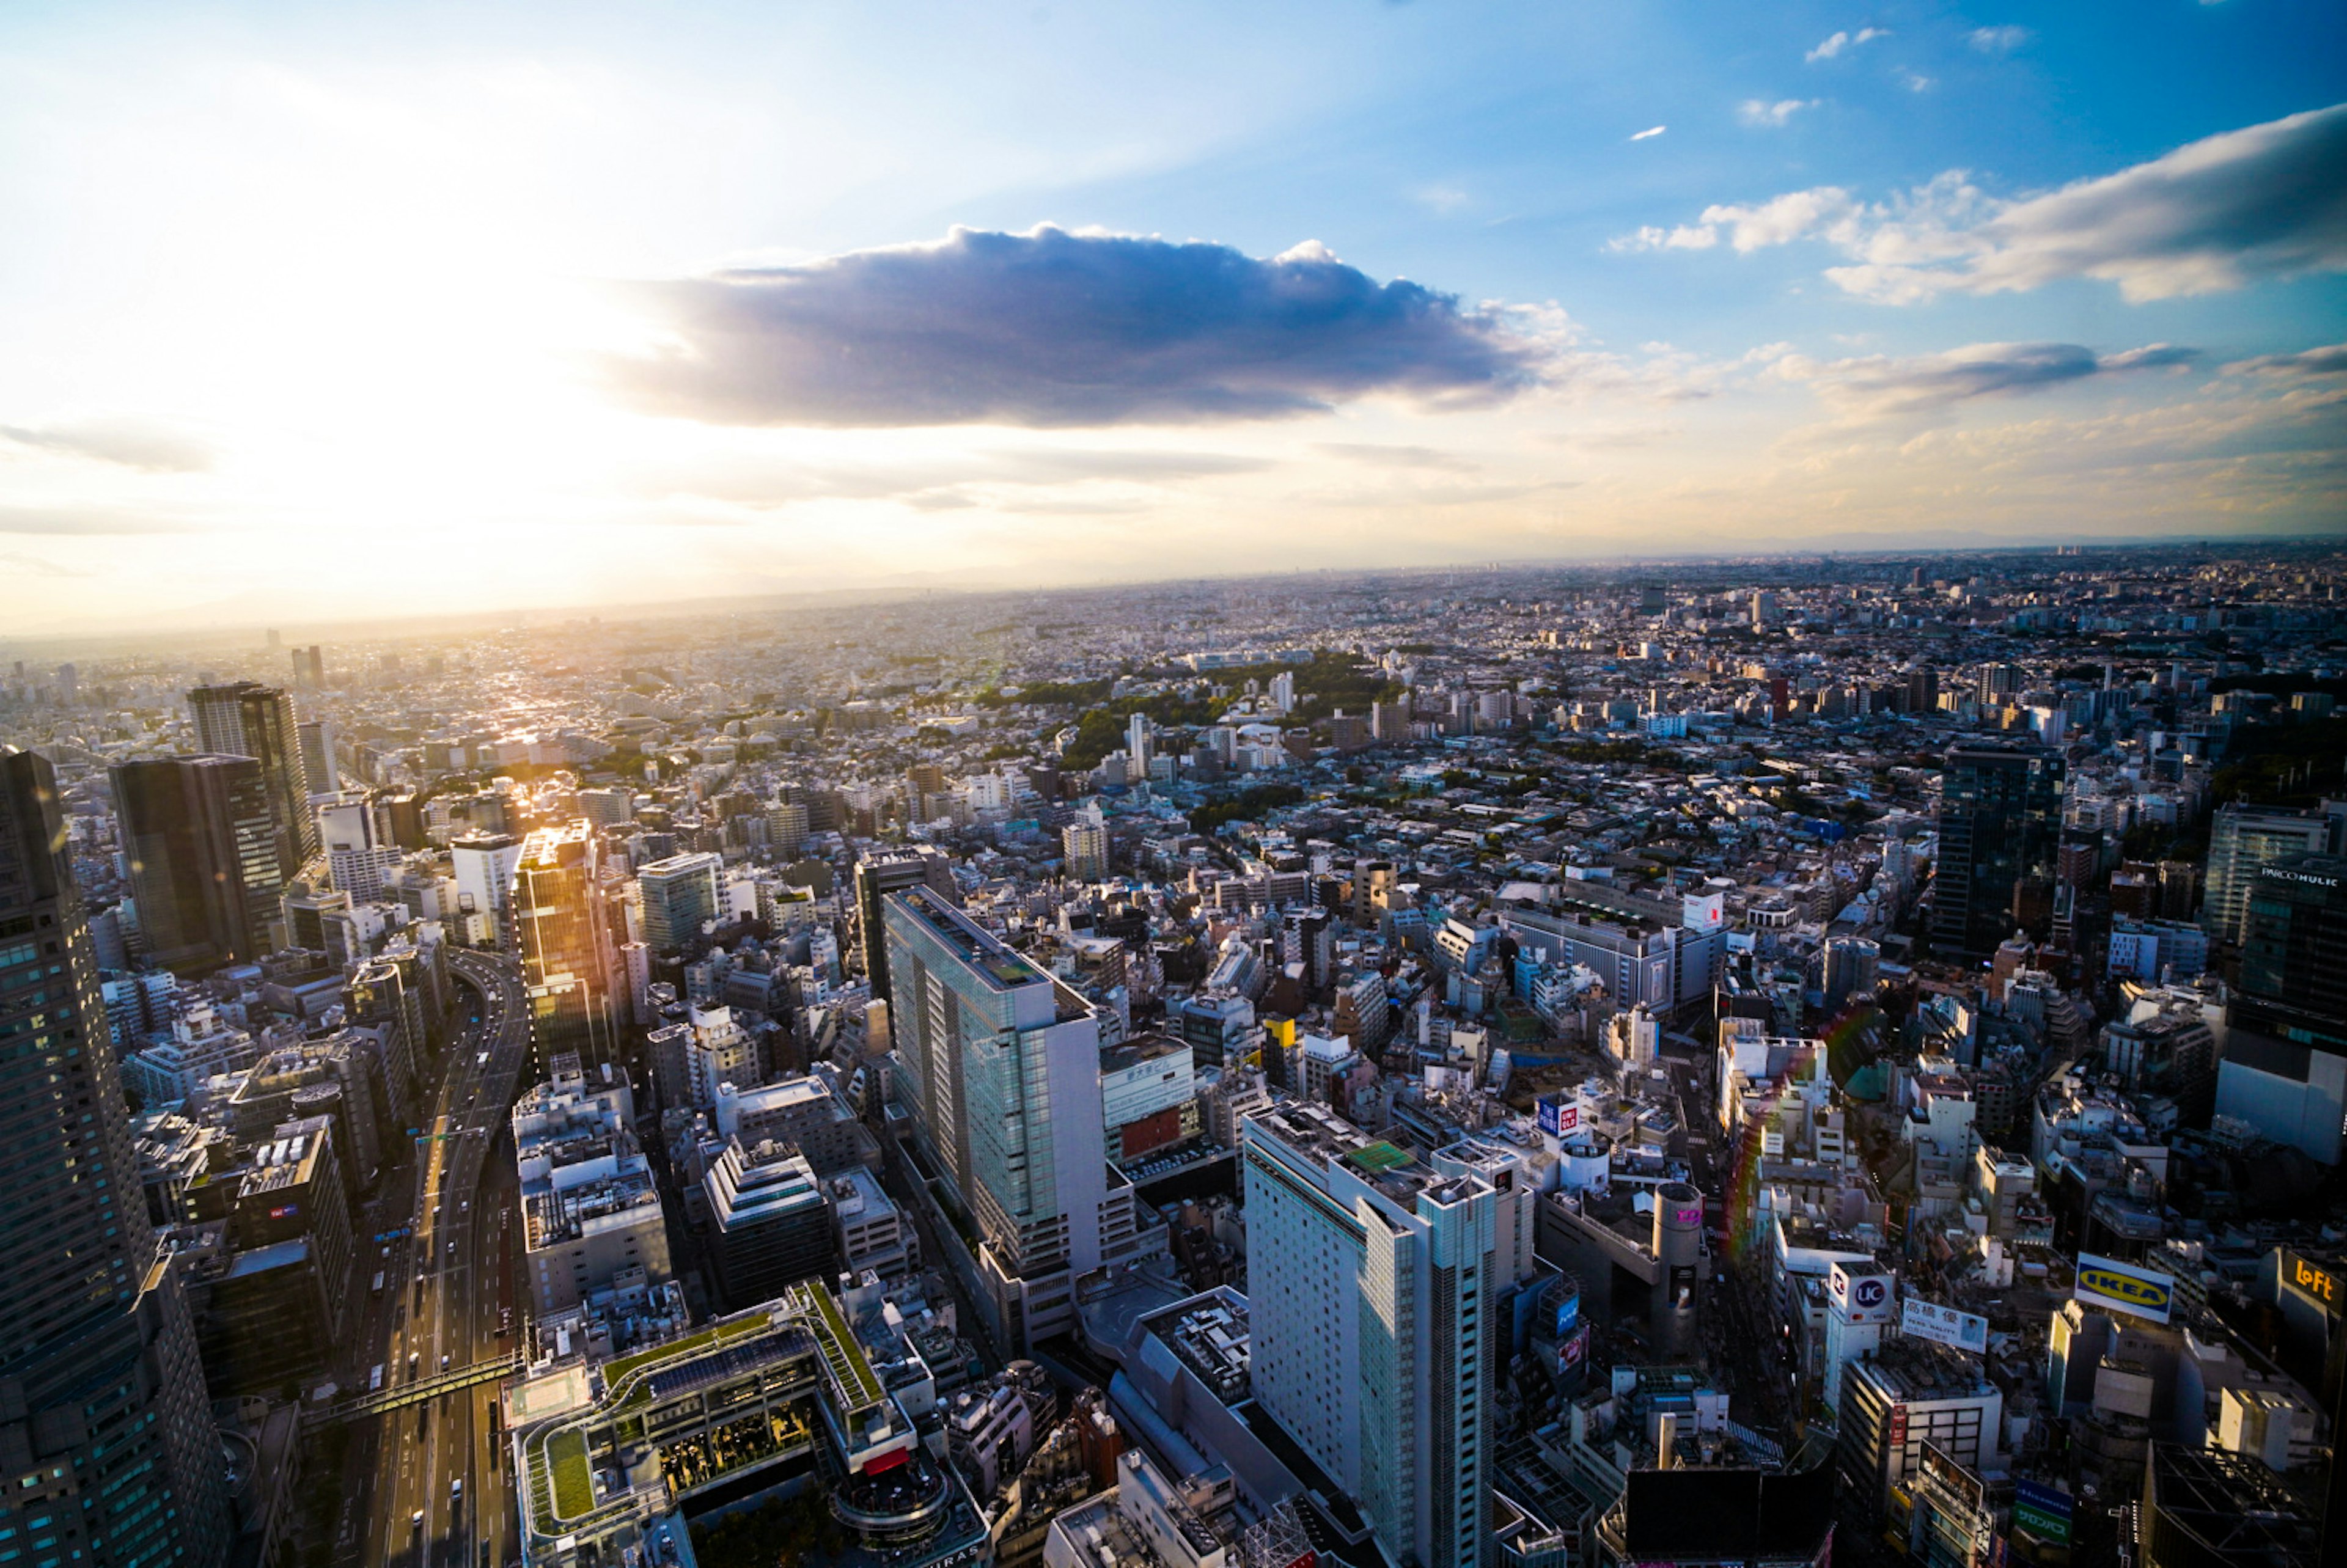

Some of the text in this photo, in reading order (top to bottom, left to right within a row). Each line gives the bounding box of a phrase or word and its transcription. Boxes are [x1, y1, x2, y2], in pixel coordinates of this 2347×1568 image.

[2262, 866, 2338, 887] PARCO HULIC
[1562, 1109, 1576, 1120] UNI
[1562, 1118, 1576, 1129] QLO
[1858, 1285, 1884, 1302] UC
[2088, 1273, 2161, 1302] IKEA
[1906, 1300, 1936, 1319] 高橋
[1908, 1317, 1955, 1335] PERSNALITY
[2018, 1509, 2066, 1536] サロンパス
